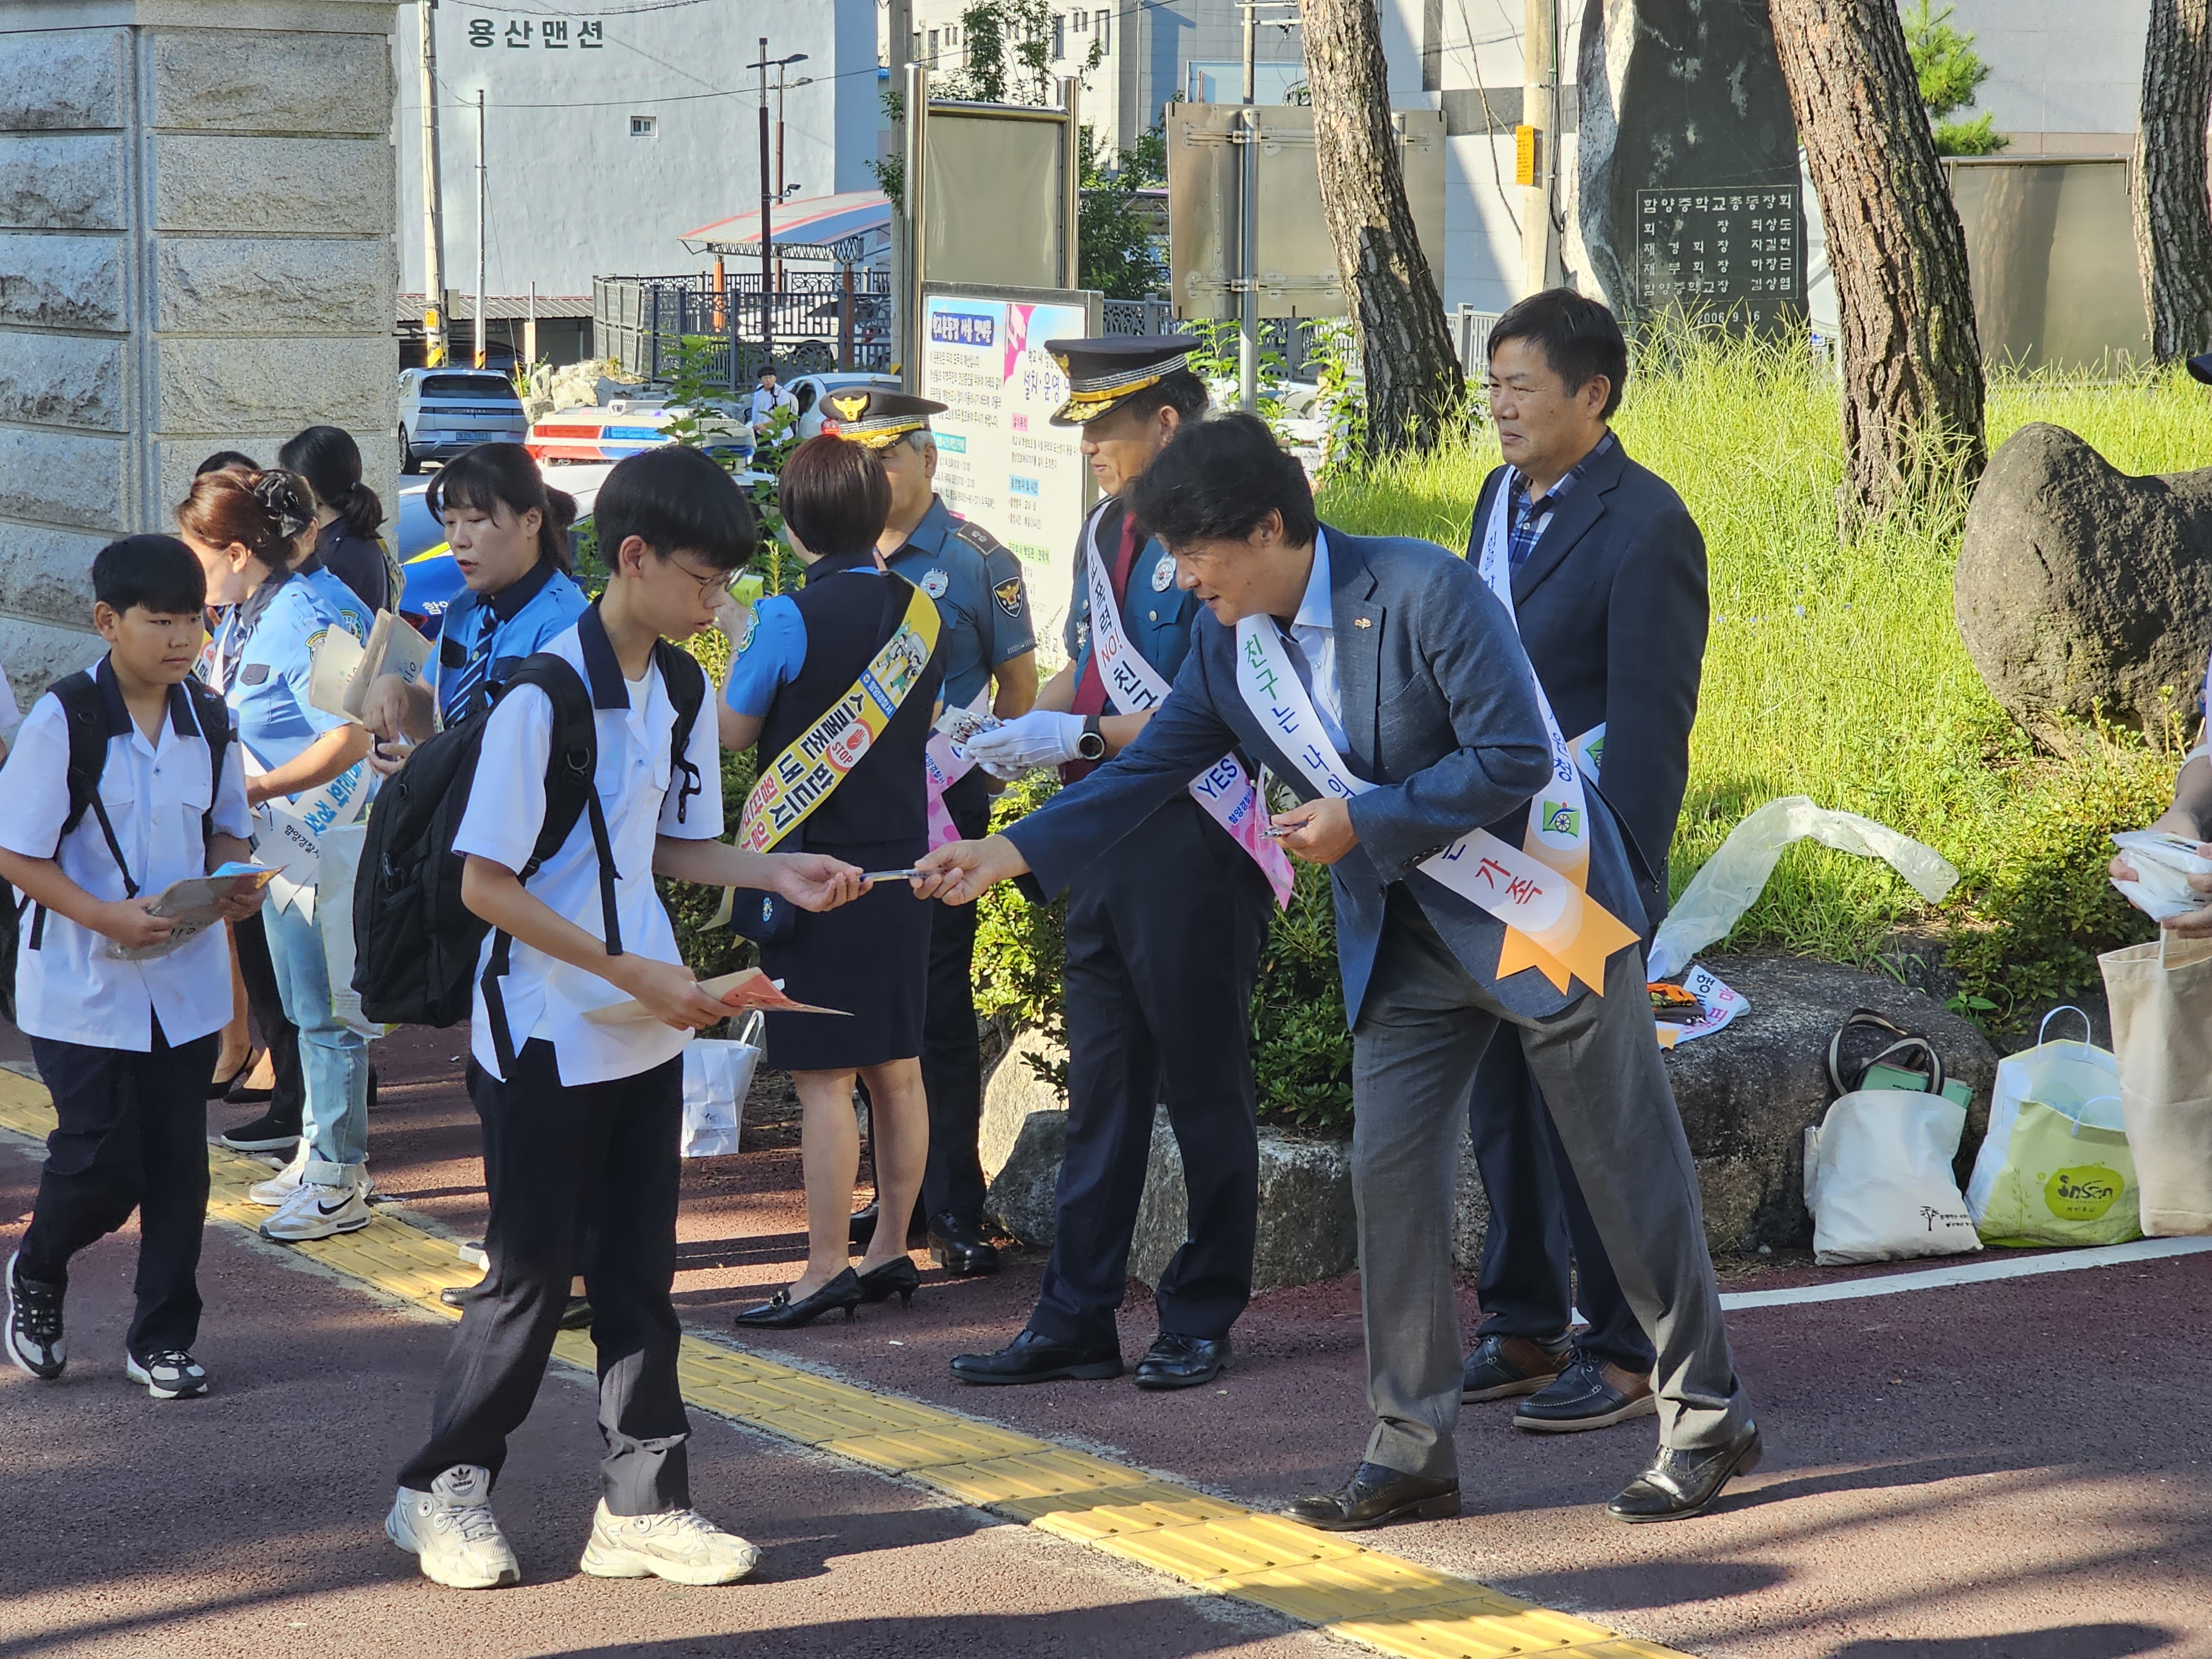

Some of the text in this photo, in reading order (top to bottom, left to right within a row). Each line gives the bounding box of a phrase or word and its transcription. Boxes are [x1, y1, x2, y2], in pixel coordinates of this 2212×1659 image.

[468, 19, 603, 49] 용산맨션
[1101, 627, 1123, 668] NO!
[868, 680, 894, 716] 함양경찰서
[1244, 633, 1300, 734] 친구는
[800, 692, 865, 761] 스쿨존
[777, 753, 805, 785] 내
[832, 741, 853, 764] STOP
[768, 762, 835, 831] 반드시
[1197, 758, 1238, 799] YES
[1475, 857, 1543, 905] 가족
[452, 1479, 473, 1488] adidas
